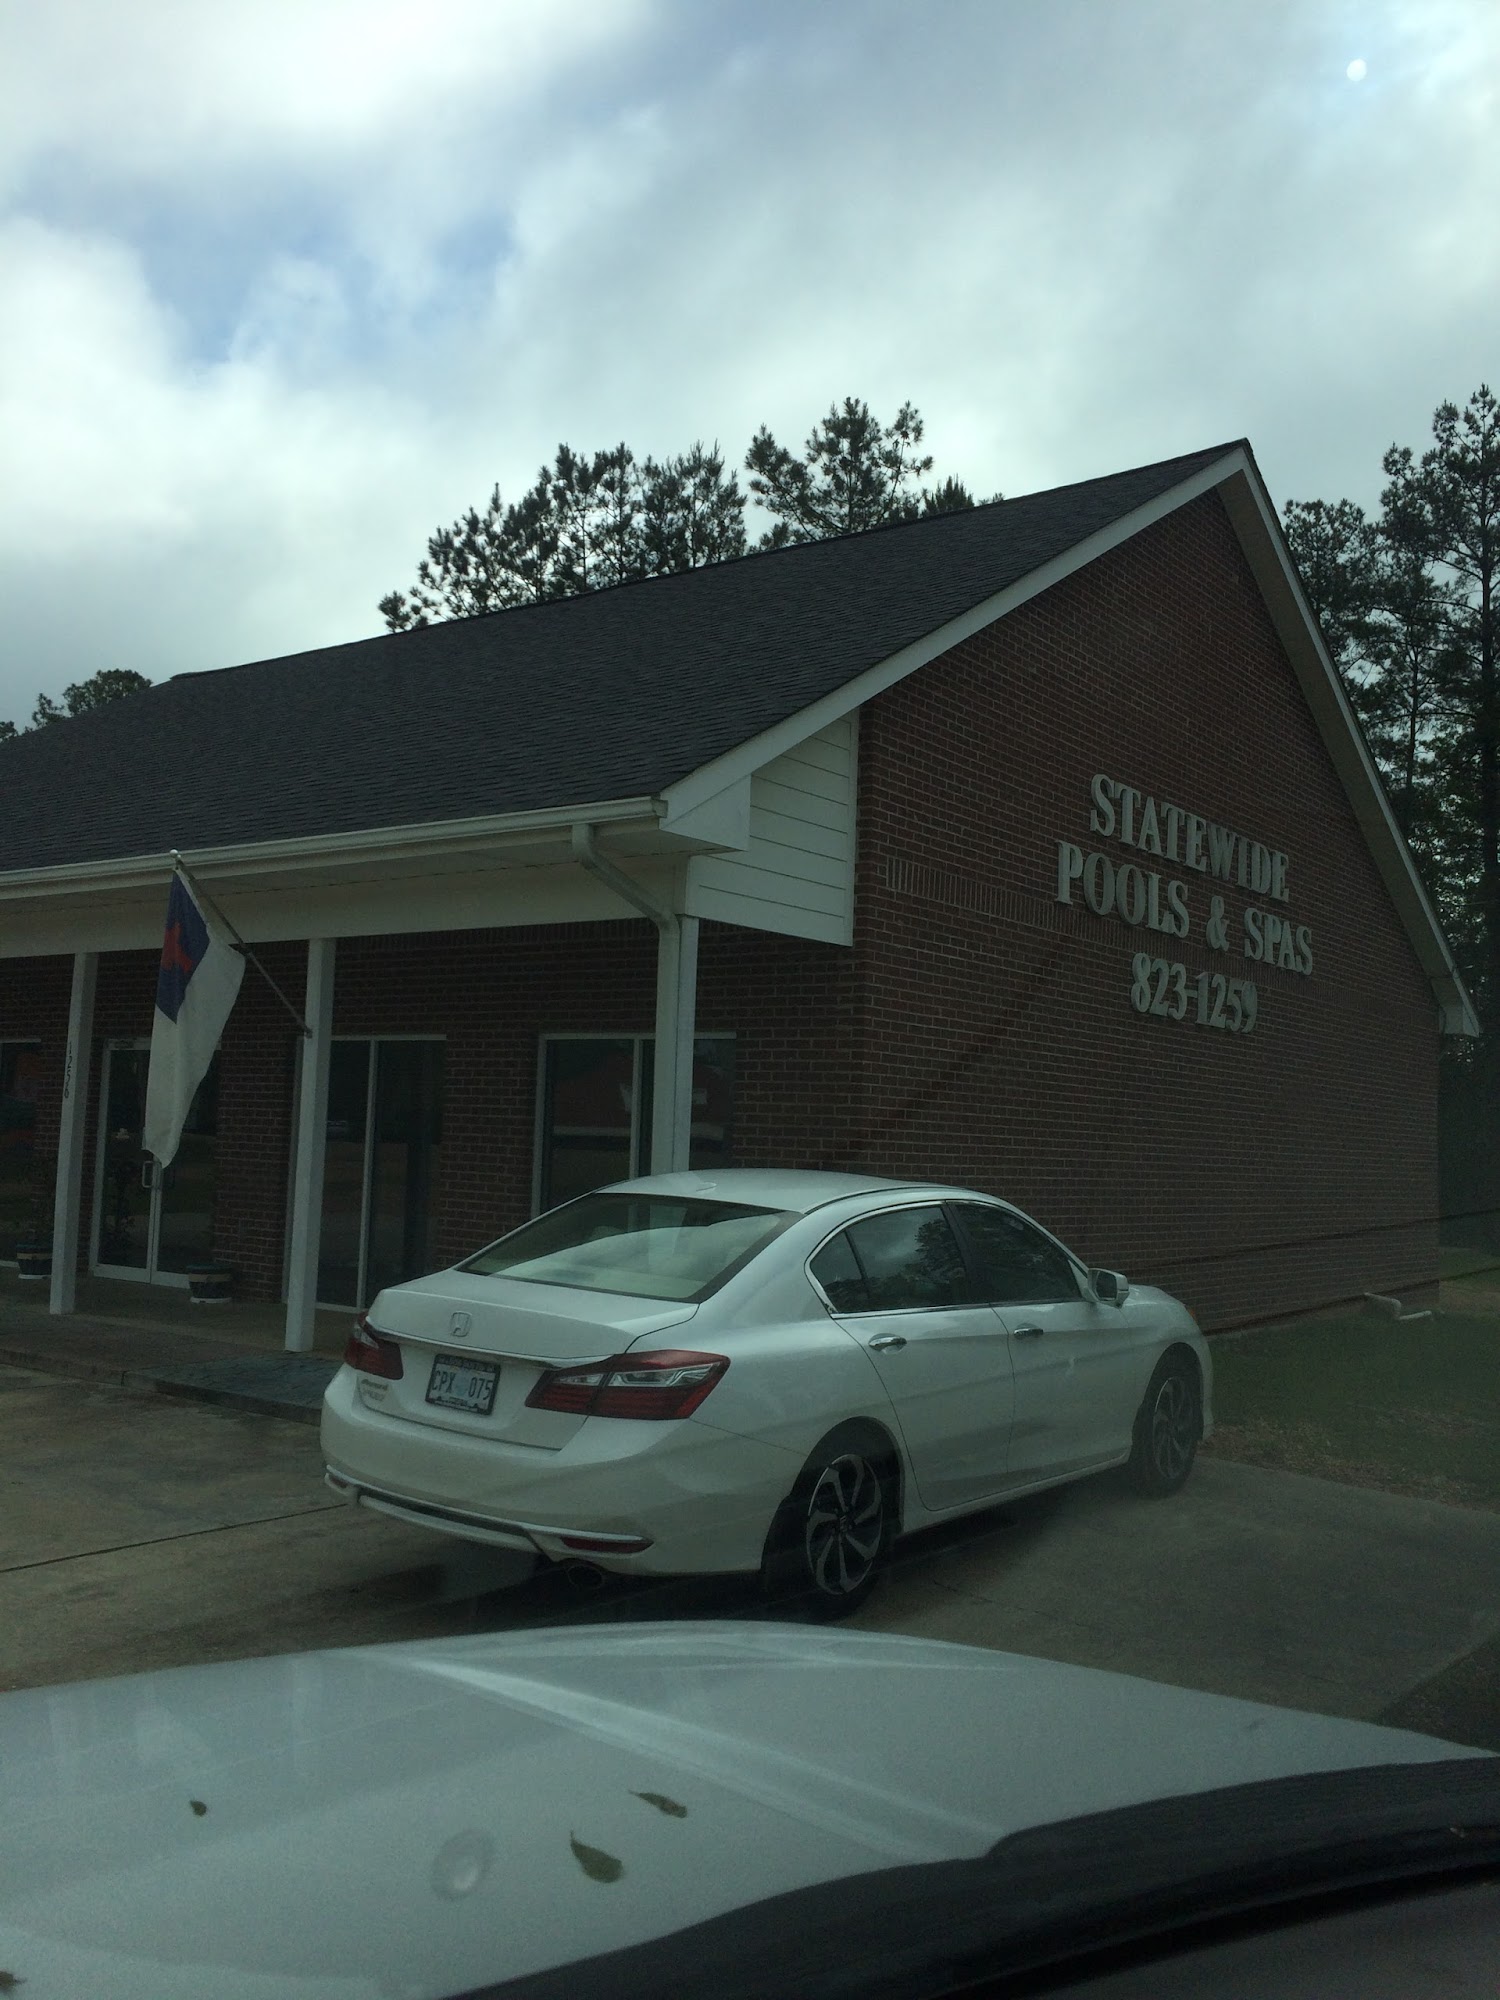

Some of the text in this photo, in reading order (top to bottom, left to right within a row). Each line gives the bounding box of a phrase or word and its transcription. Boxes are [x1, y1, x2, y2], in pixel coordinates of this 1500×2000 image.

[1090, 773, 1290, 903] STATEWIDE
[1055, 839, 1314, 976] POOLS & SPAS
[1131, 951, 1258, 1034] 823-1259
[431, 1369, 494, 1401] CPX 075
